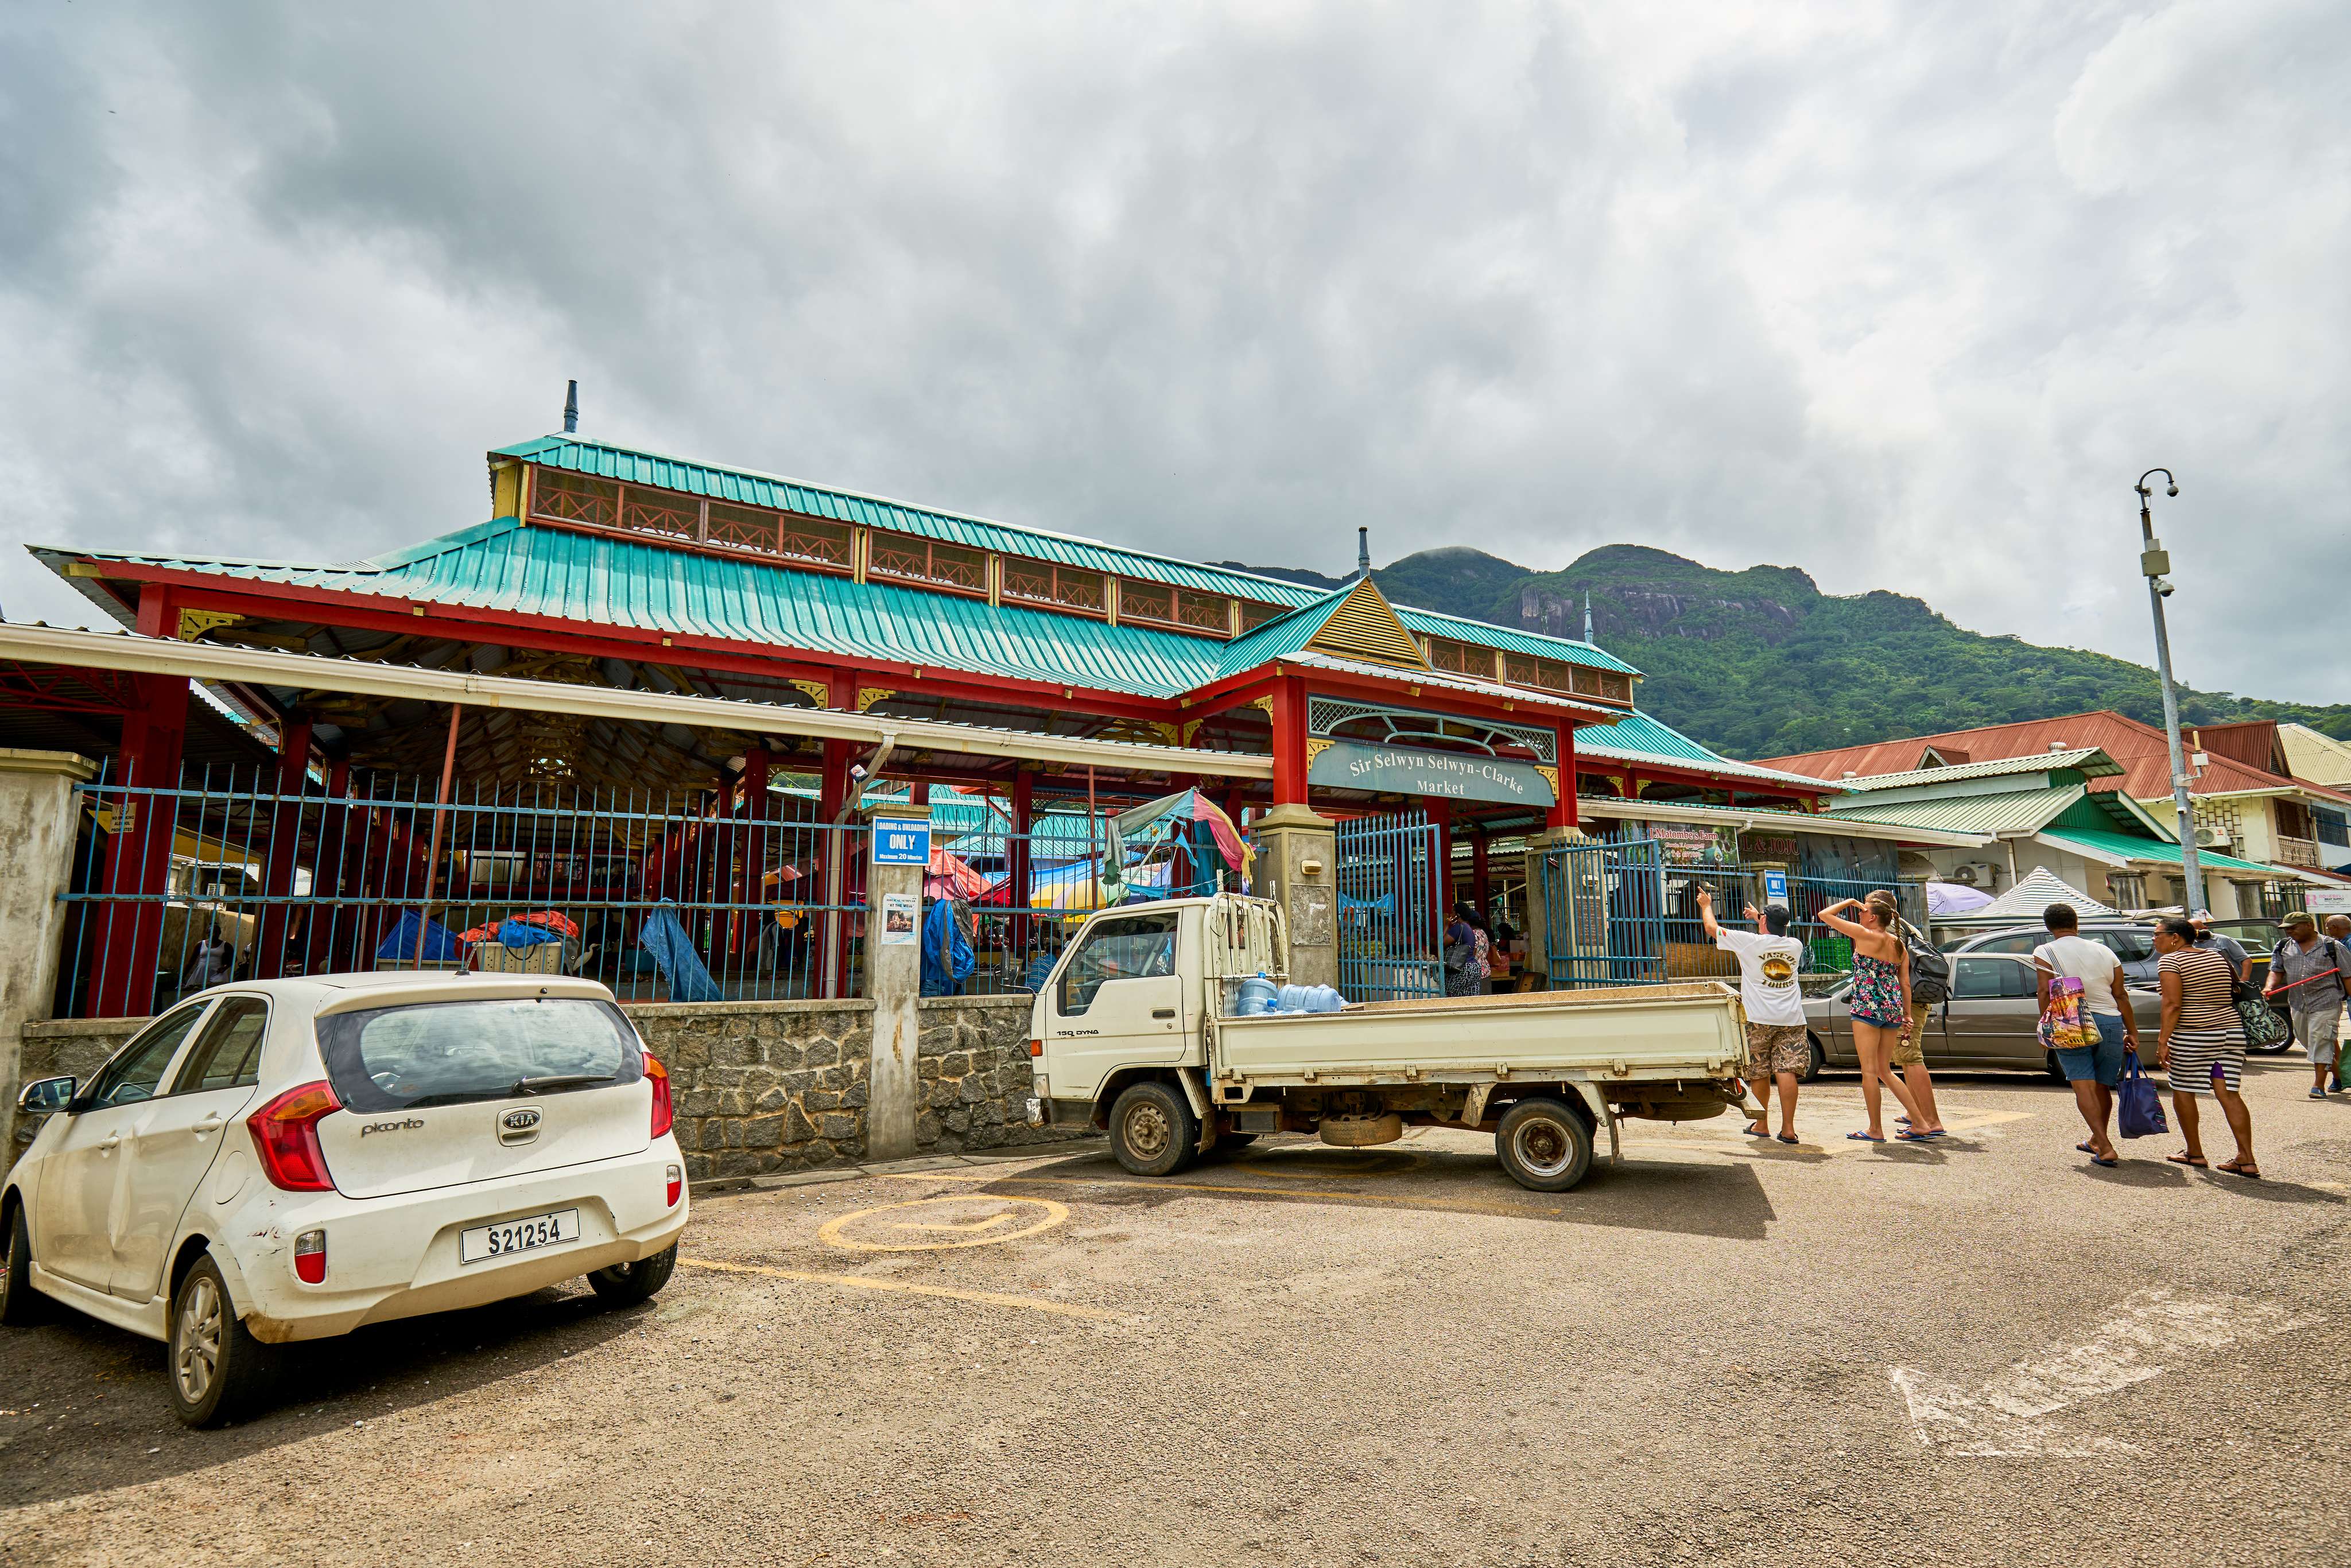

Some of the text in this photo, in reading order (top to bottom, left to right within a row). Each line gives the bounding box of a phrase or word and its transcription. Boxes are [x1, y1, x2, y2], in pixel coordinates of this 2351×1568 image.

[1350, 753, 1523, 794] Sir Selwyn Selwyn-Clarke
[1417, 780, 1464, 795] Market
[877, 822, 897, 830] LOADING
[902, 823, 928, 832] UNLOADING
[1650, 828, 1718, 840] J.Matombe's Farm
[889, 834, 915, 850] ONLY
[1755, 836, 1766, 853] &
[1762, 979, 1794, 988] TOURS
[362, 1117, 424, 1138] picanto
[510, 1115, 534, 1126] KIA
[488, 1218, 560, 1254] S21254
